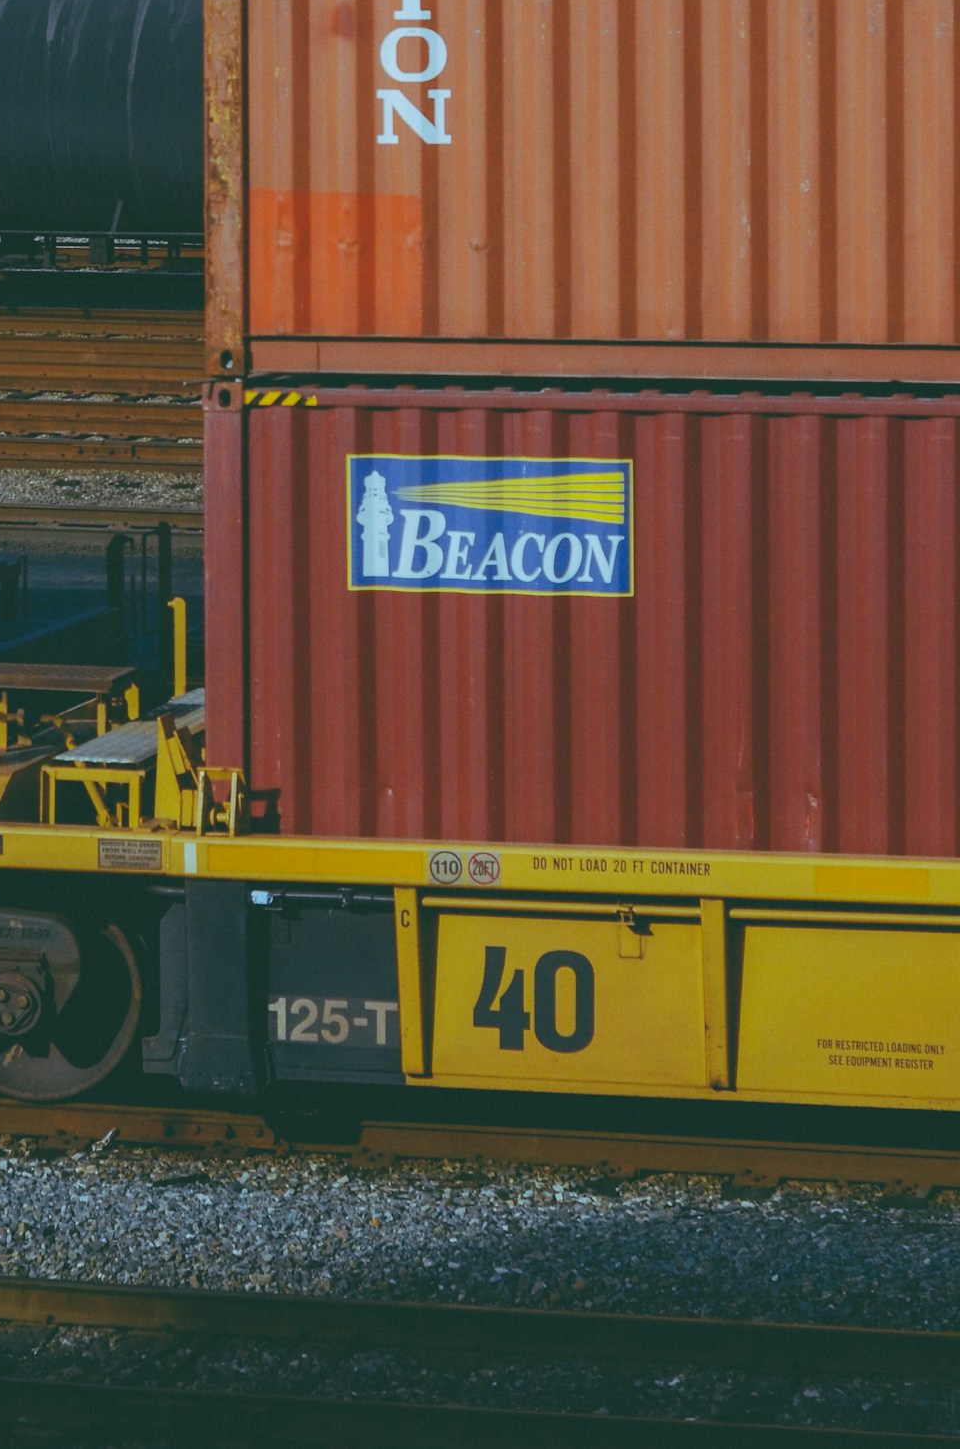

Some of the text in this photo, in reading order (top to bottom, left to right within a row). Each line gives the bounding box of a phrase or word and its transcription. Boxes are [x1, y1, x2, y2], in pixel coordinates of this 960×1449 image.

[392, 509, 624, 583] BEACON
[434, 860, 458, 875] 110
[533, 857, 711, 876] DO NOT LOAD 20 FT CONTAINER
[400, 909, 410, 928] C
[473, 945, 594, 1053] 40
[267, 997, 398, 1045] 125-T
[817, 1039, 945, 1055] FOR RESTRICTED LOADING ONLY
[829, 1054, 934, 1070] SEE EQUIPMENT REGISTER
